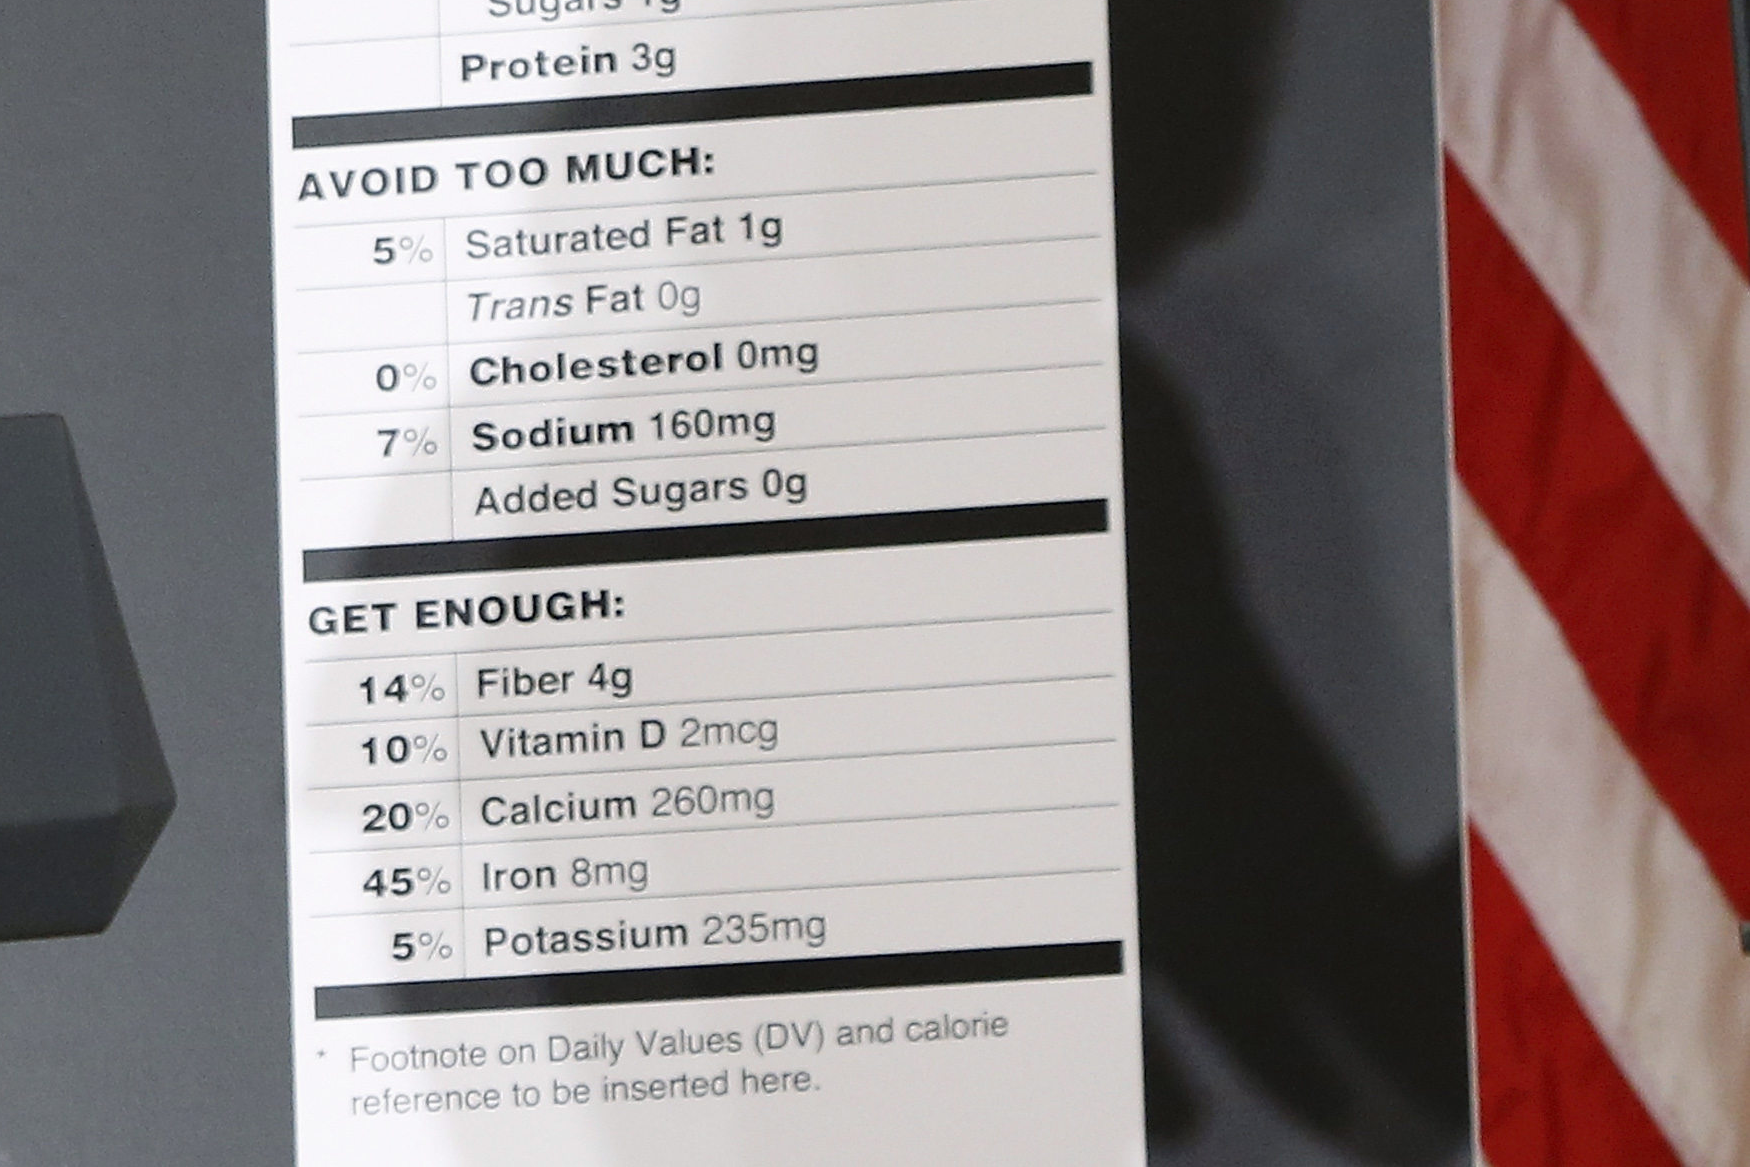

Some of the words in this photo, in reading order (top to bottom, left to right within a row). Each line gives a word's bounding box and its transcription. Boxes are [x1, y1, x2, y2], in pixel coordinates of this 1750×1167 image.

[462, 46, 617, 82] Protein
[632, 43, 675, 78] 3g
[299, 165, 438, 201] AVOID
[455, 157, 548, 189] TOO
[567, 147, 713, 183] MUCH:
[374, 237, 431, 265] 5%
[467, 219, 650, 259] Saturated
[667, 216, 724, 245] Fat
[740, 213, 782, 248] 1g
[468, 292, 573, 321] Trans
[587, 285, 643, 314] Fat
[658, 280, 700, 317] 0g
[376, 364, 436, 392] 0%
[470, 343, 722, 386] Cholesterol
[737, 340, 818, 374] 0mg
[377, 428, 437, 457] 7%
[473, 417, 634, 451] Sodium
[651, 409, 775, 442] 160mg
[475, 480, 597, 516] Added
[613, 477, 748, 512] Sugars
[763, 468, 807, 504] 0g
[309, 603, 397, 635] GET
[416, 590, 623, 629] ENOUGH:
[360, 675, 444, 704] 14%
[478, 667, 574, 698] Fiber
[588, 663, 632, 698] 4g
[362, 736, 446, 764] 10%
[480, 723, 624, 758] Vitamin
[641, 719, 665, 748] D
[681, 717, 777, 751] 2mcg
[363, 802, 448, 833] 20%
[481, 792, 636, 826] Calcium
[652, 785, 774, 820] 260mg
[363, 868, 450, 896] 45%
[484, 863, 556, 891] Iron
[571, 857, 648, 892] 8mg
[393, 933, 451, 961] 5%
[485, 920, 688, 956] Potassium
[703, 913, 825, 948] 235mg
[351, 1043, 486, 1072] Footnote
[498, 1043, 535, 1065] on
[548, 1032, 624, 1066] Daily
[635, 1029, 742, 1056] Values
[754, 1020, 824, 1056] (DV)
[837, 1017, 894, 1046] and
[904, 1012, 1009, 1042] calorie
[352, 1088, 500, 1115] reference
[512, 1082, 540, 1107] to
[553, 1079, 590, 1105] be
[603, 1070, 728, 1102] inserted
[741, 1068, 820, 1094] here.
